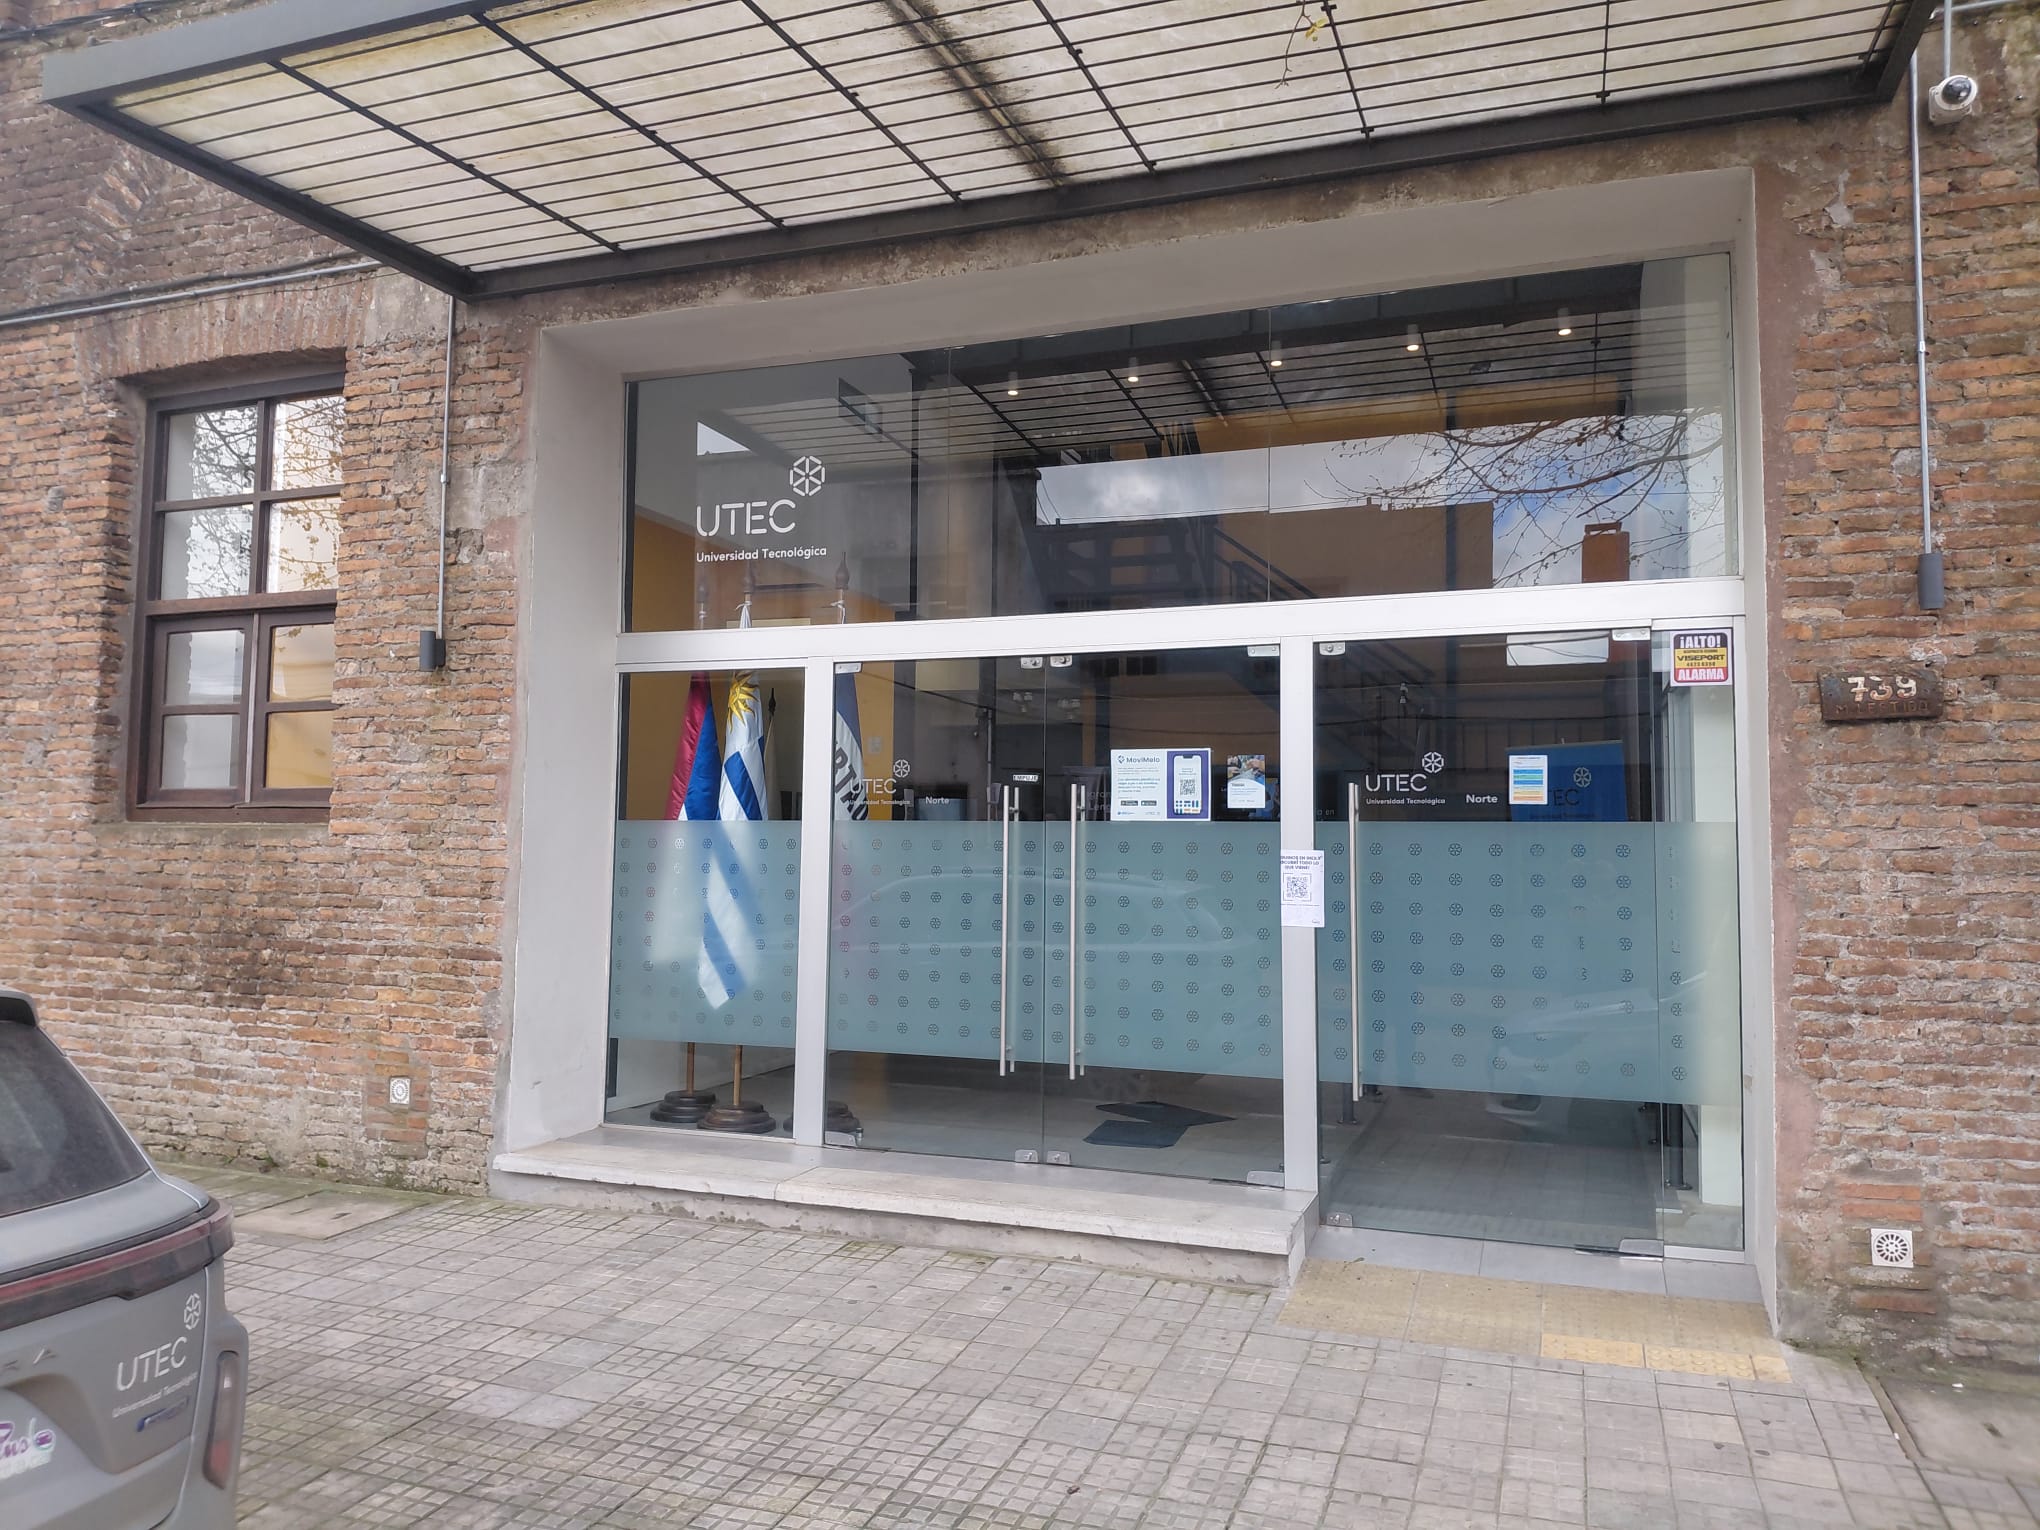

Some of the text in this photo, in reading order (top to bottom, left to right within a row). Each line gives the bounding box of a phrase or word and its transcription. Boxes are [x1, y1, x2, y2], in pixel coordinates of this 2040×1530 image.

[696, 499, 796, 537] UTEC
[696, 545, 827, 563] Universidad Tecnológica
[1680, 634, 1721, 649] ¡ALTO!
[1676, 654, 1726, 662] VISEPORT
[1677, 668, 1725, 681] ALARMA
[1847, 675, 1917, 702] 739
[1126, 756, 1161, 764] MoviMelo
[1013, 774, 1039, 782] EMPUJE
[1365, 773, 1428, 792] UTEC
[849, 778, 897, 794] UTEC
[925, 796, 950, 805] Norte
[1366, 797, 1405, 806] Universidad
[1465, 794, 1498, 804] Norte
[117, 1336, 187, 1392] UTEC
